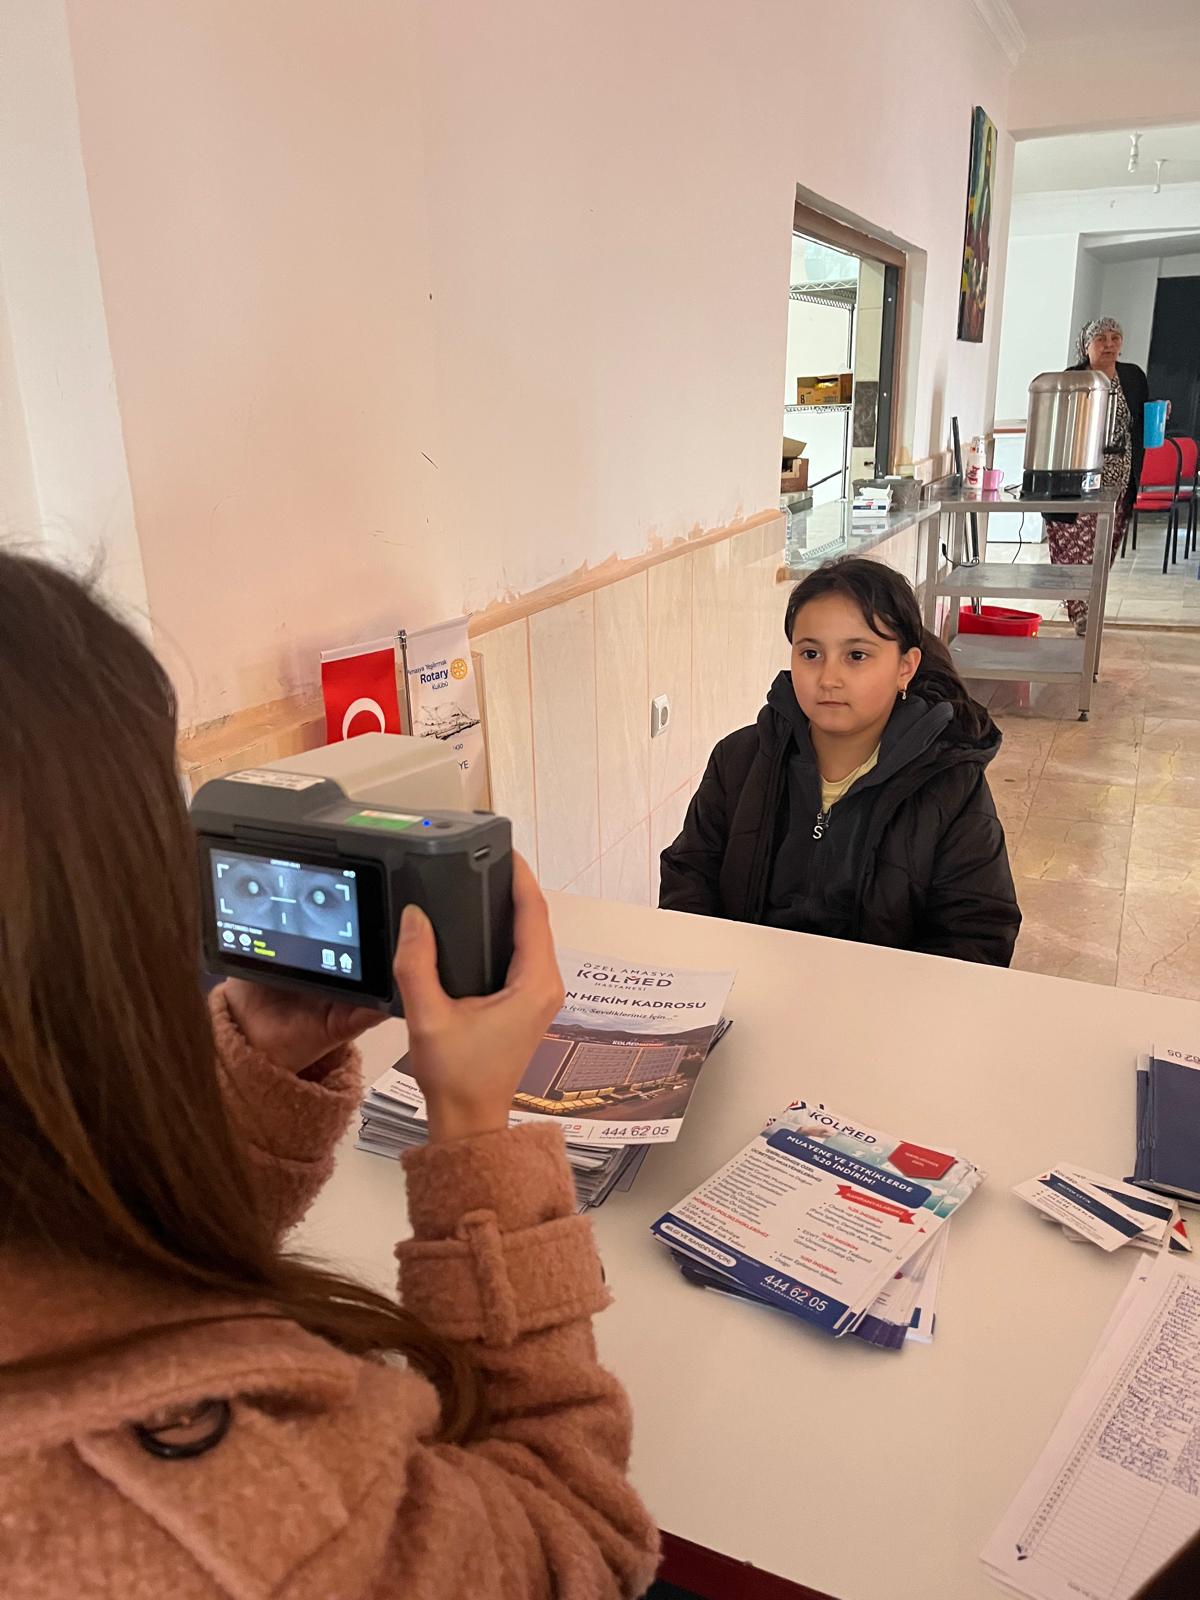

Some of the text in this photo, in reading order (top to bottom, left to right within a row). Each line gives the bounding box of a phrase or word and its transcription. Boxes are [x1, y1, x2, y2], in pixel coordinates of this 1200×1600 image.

[420, 668, 448, 684] Rotary
[457, 760, 469, 770] YE
[576, 969, 672, 987] KOLMED
[583, 962, 675, 978] ÖZEL AMASYA
[580, 993, 629, 1006] HEKİM
[631, 999, 707, 1009] KADROSU
[589, 1007, 647, 1019] Sevdikleriniz
[601, 1125, 670, 1136] 444 62 05
[810, 1111, 877, 1144] KOLMED
[786, 1136, 833, 1160] MUAYENE
[835, 1155, 847, 1165] VE
[848, 1162, 914, 1193] TETKİKLERDE
[812, 1154, 877, 1185] %20 İNDİRİM!
[764, 1275, 790, 1291] 444
[790, 1287, 809, 1302] 62
[808, 1297, 828, 1311] 05
